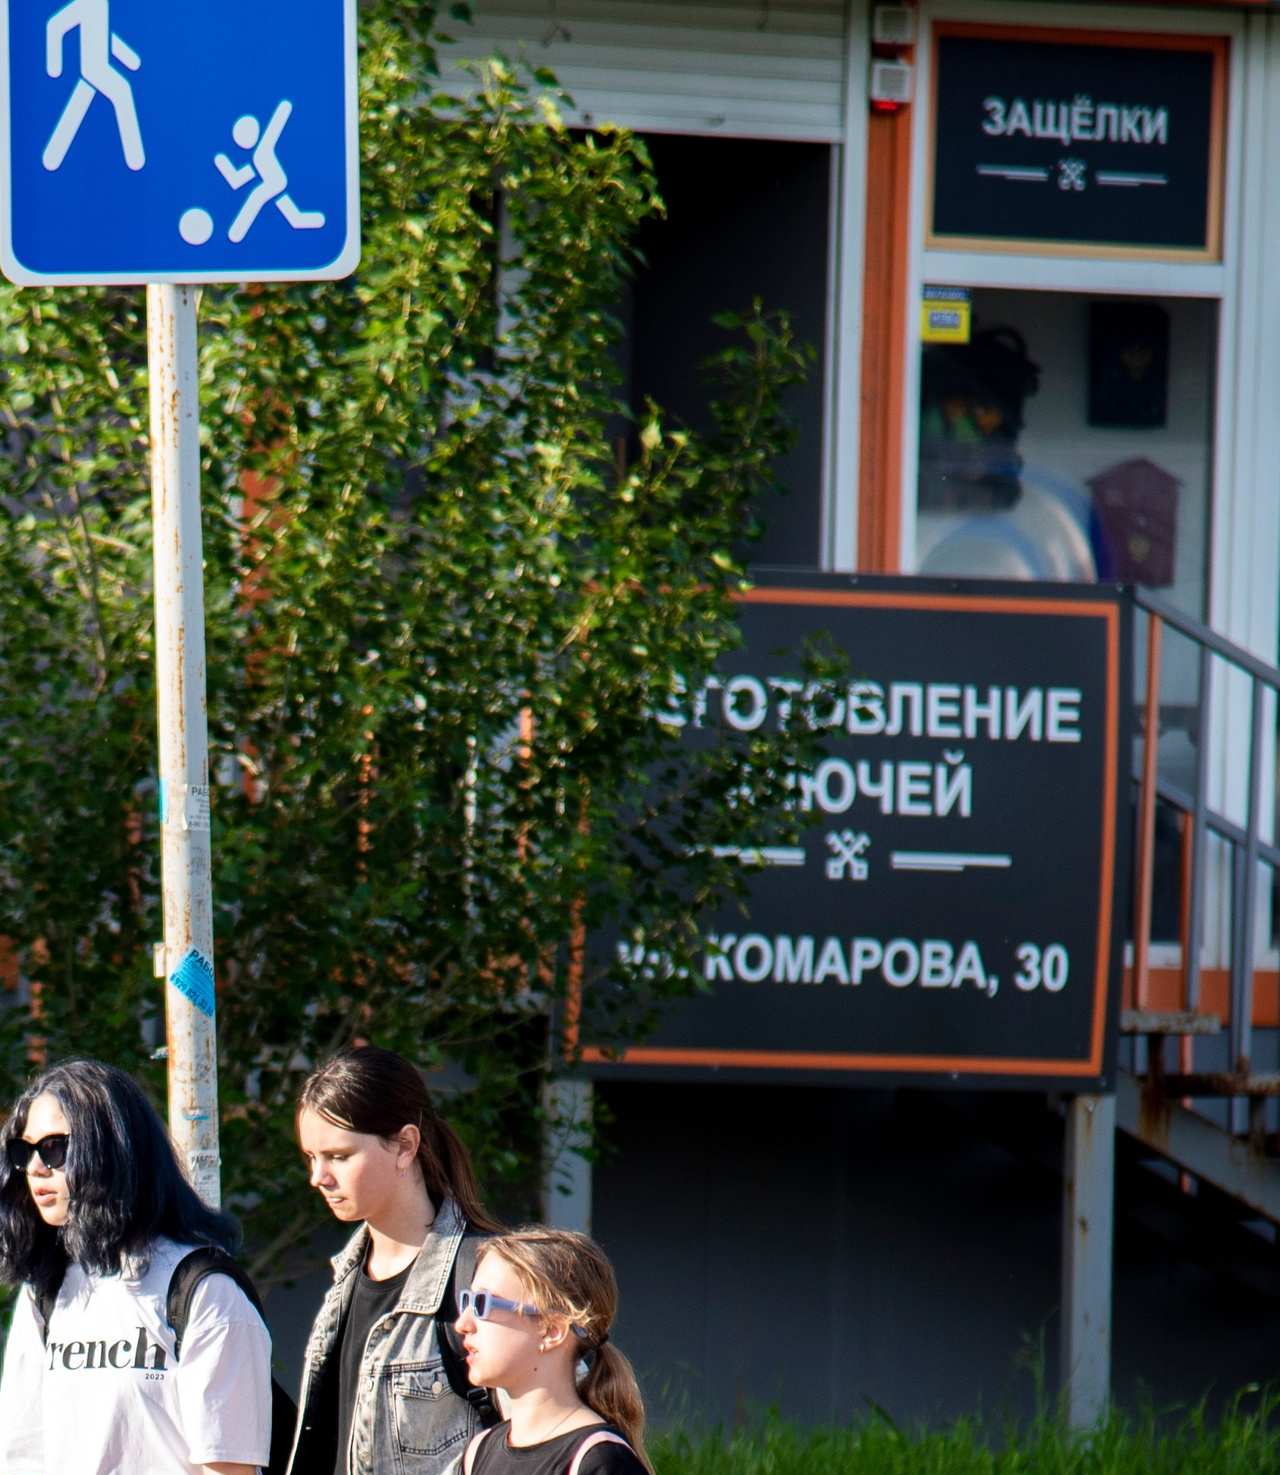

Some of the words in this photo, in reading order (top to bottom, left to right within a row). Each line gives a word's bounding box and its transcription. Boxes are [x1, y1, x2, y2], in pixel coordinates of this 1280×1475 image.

[982, 93, 1169, 146] ЗАЩЁЛКИ
[704, 931, 999, 998] КОМАРОВА,
[1014, 941, 1070, 993] 30
[47, 1326, 168, 1371] rench
[145, 1373, 165, 1381] 2023
